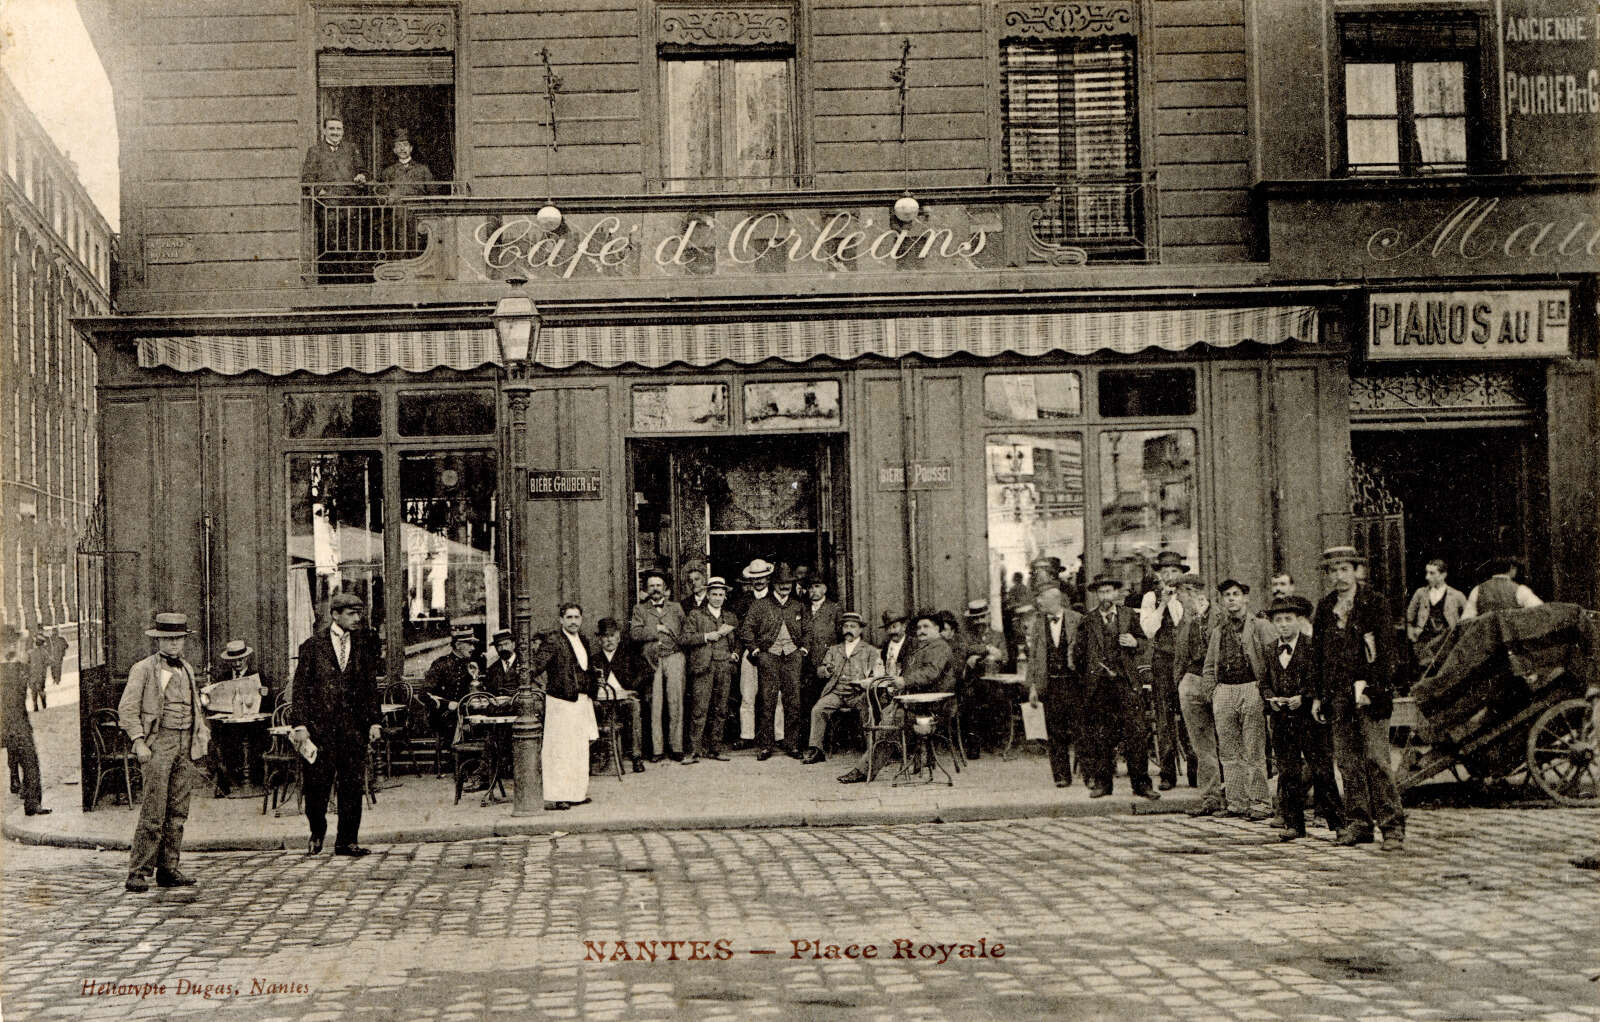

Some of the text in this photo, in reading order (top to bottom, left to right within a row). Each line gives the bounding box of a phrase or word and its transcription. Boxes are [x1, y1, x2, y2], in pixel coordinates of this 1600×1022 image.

[1507, 16, 1588, 41] ANCIENNE
[1507, 71, 1577, 114] POIRIER
[475, 213, 639, 280] Café
[1373, 301, 1492, 346] PIANOS
[1498, 311, 1531, 344] AU
[554, 476, 586, 492] GRUBER
